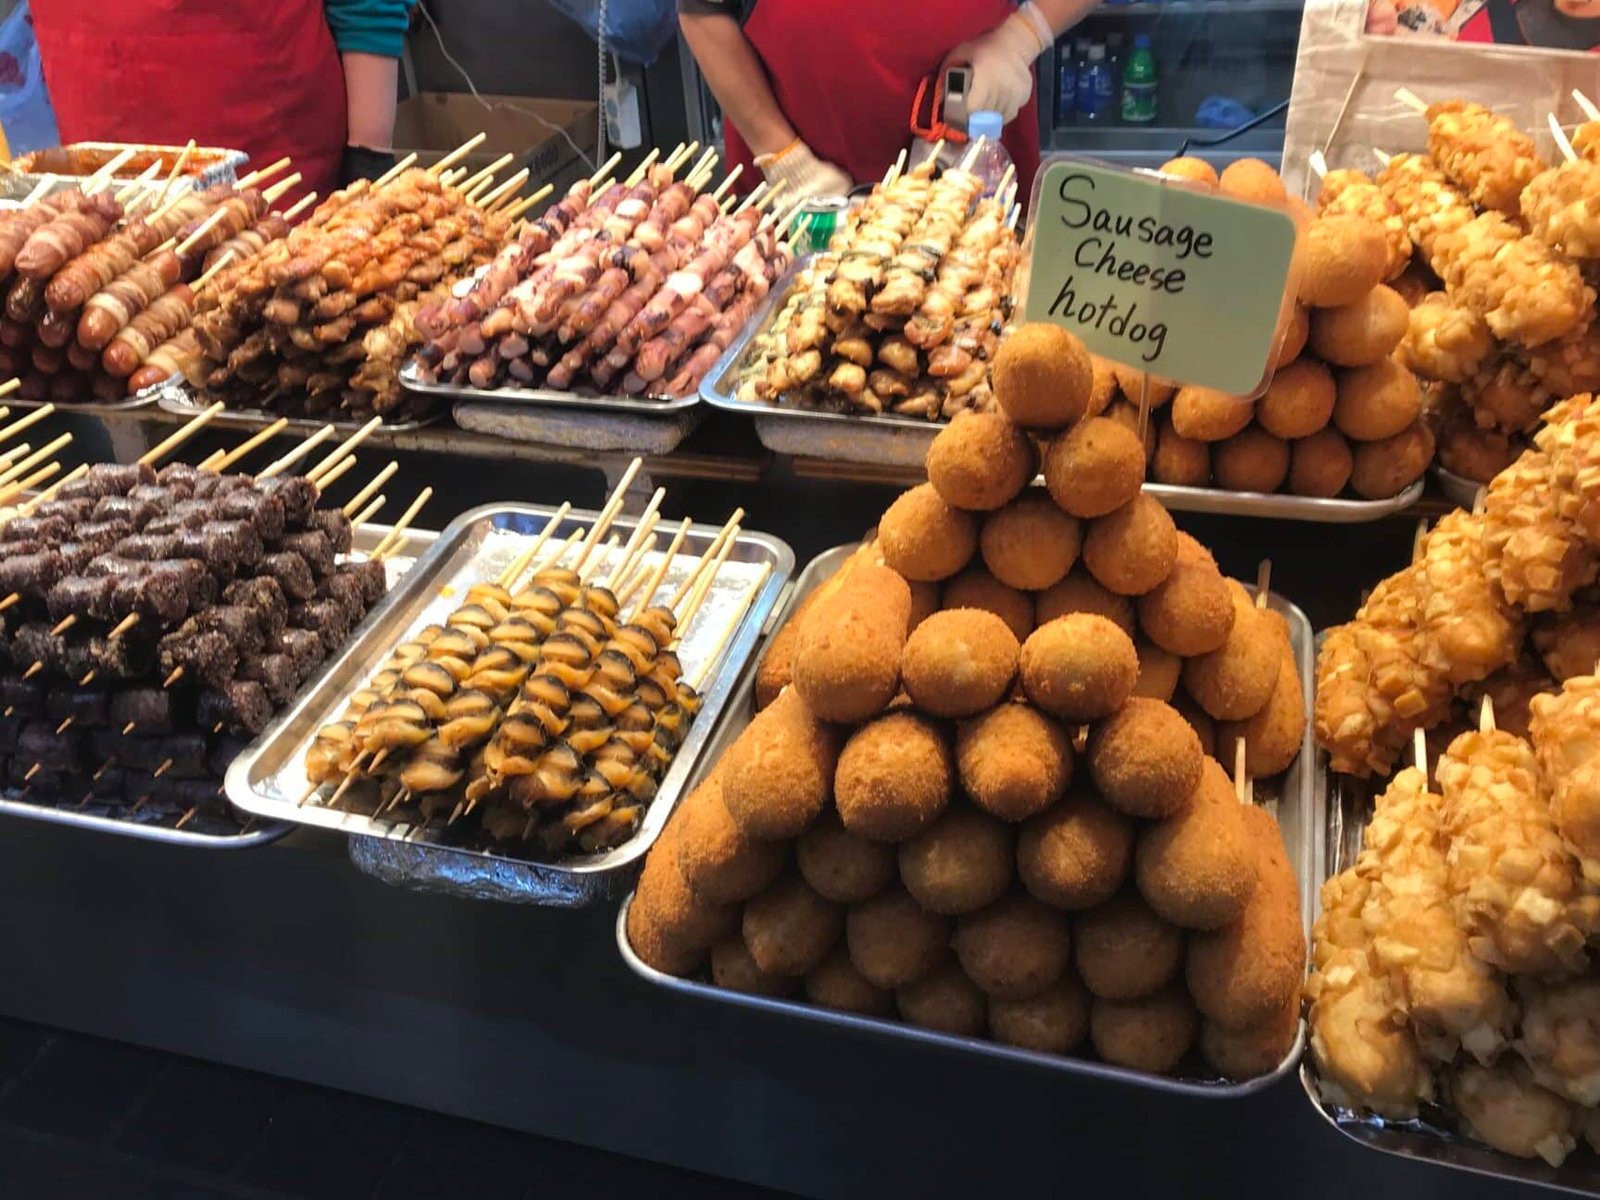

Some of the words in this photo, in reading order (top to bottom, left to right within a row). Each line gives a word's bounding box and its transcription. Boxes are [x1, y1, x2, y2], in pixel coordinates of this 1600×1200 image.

[1059, 174, 1213, 258] Sausage
[1074, 237, 1186, 293] Cheese
[1048, 275, 1168, 362] hotdog
